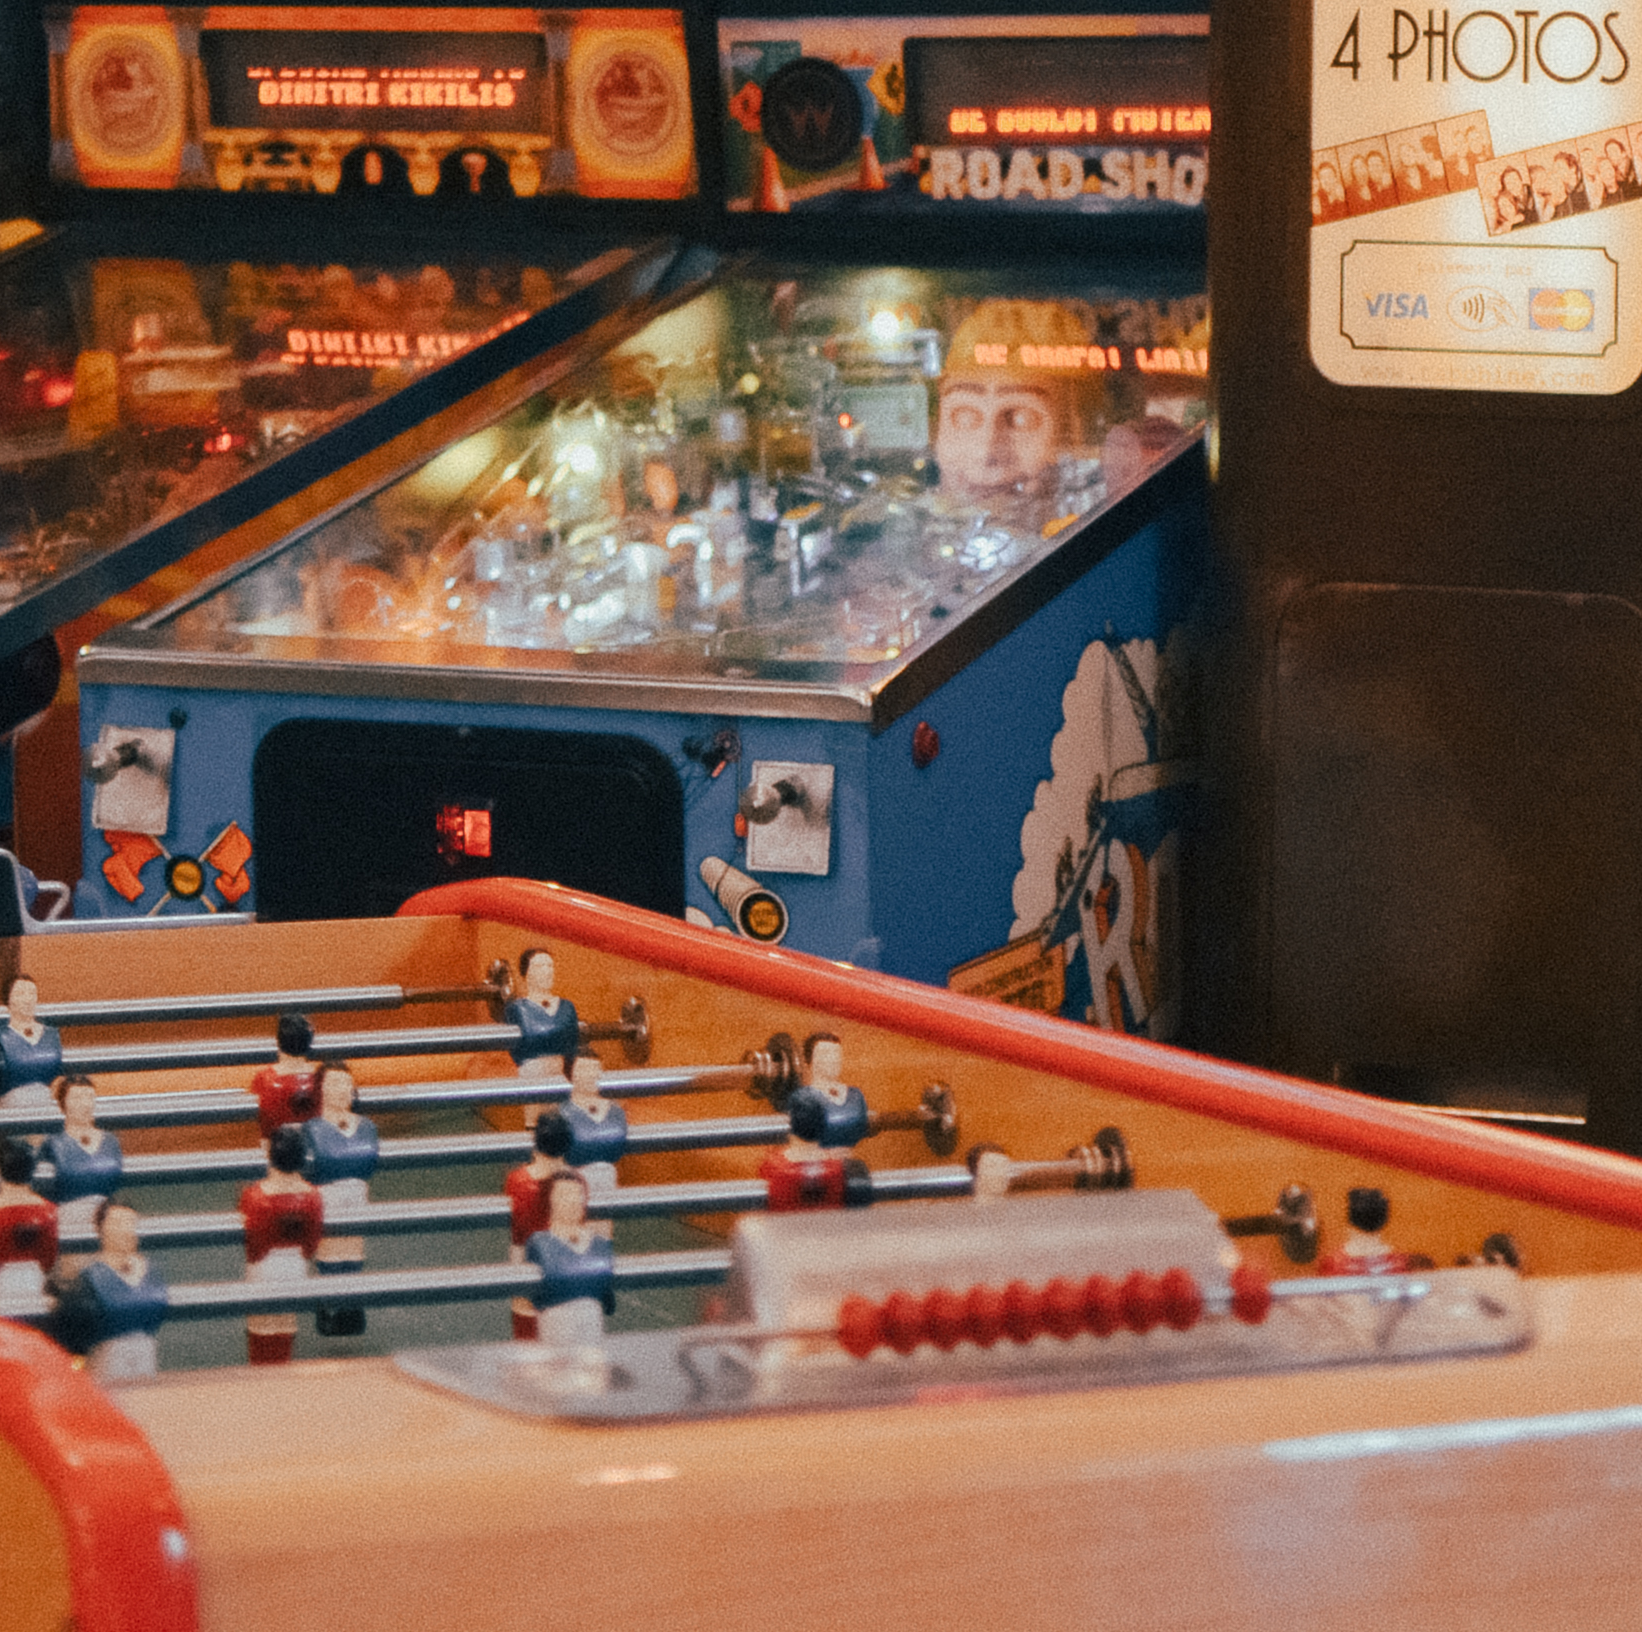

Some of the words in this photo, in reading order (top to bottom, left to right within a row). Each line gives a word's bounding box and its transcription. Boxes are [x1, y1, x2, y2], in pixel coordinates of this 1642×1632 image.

[1329, 7, 1362, 82] 4
[1387, 7, 1630, 85] PHOTOS
[930, 148, 1085, 201] ROAD
[1101, 149, 1207, 207] SHO
[1363, 292, 1430, 319] VISA
